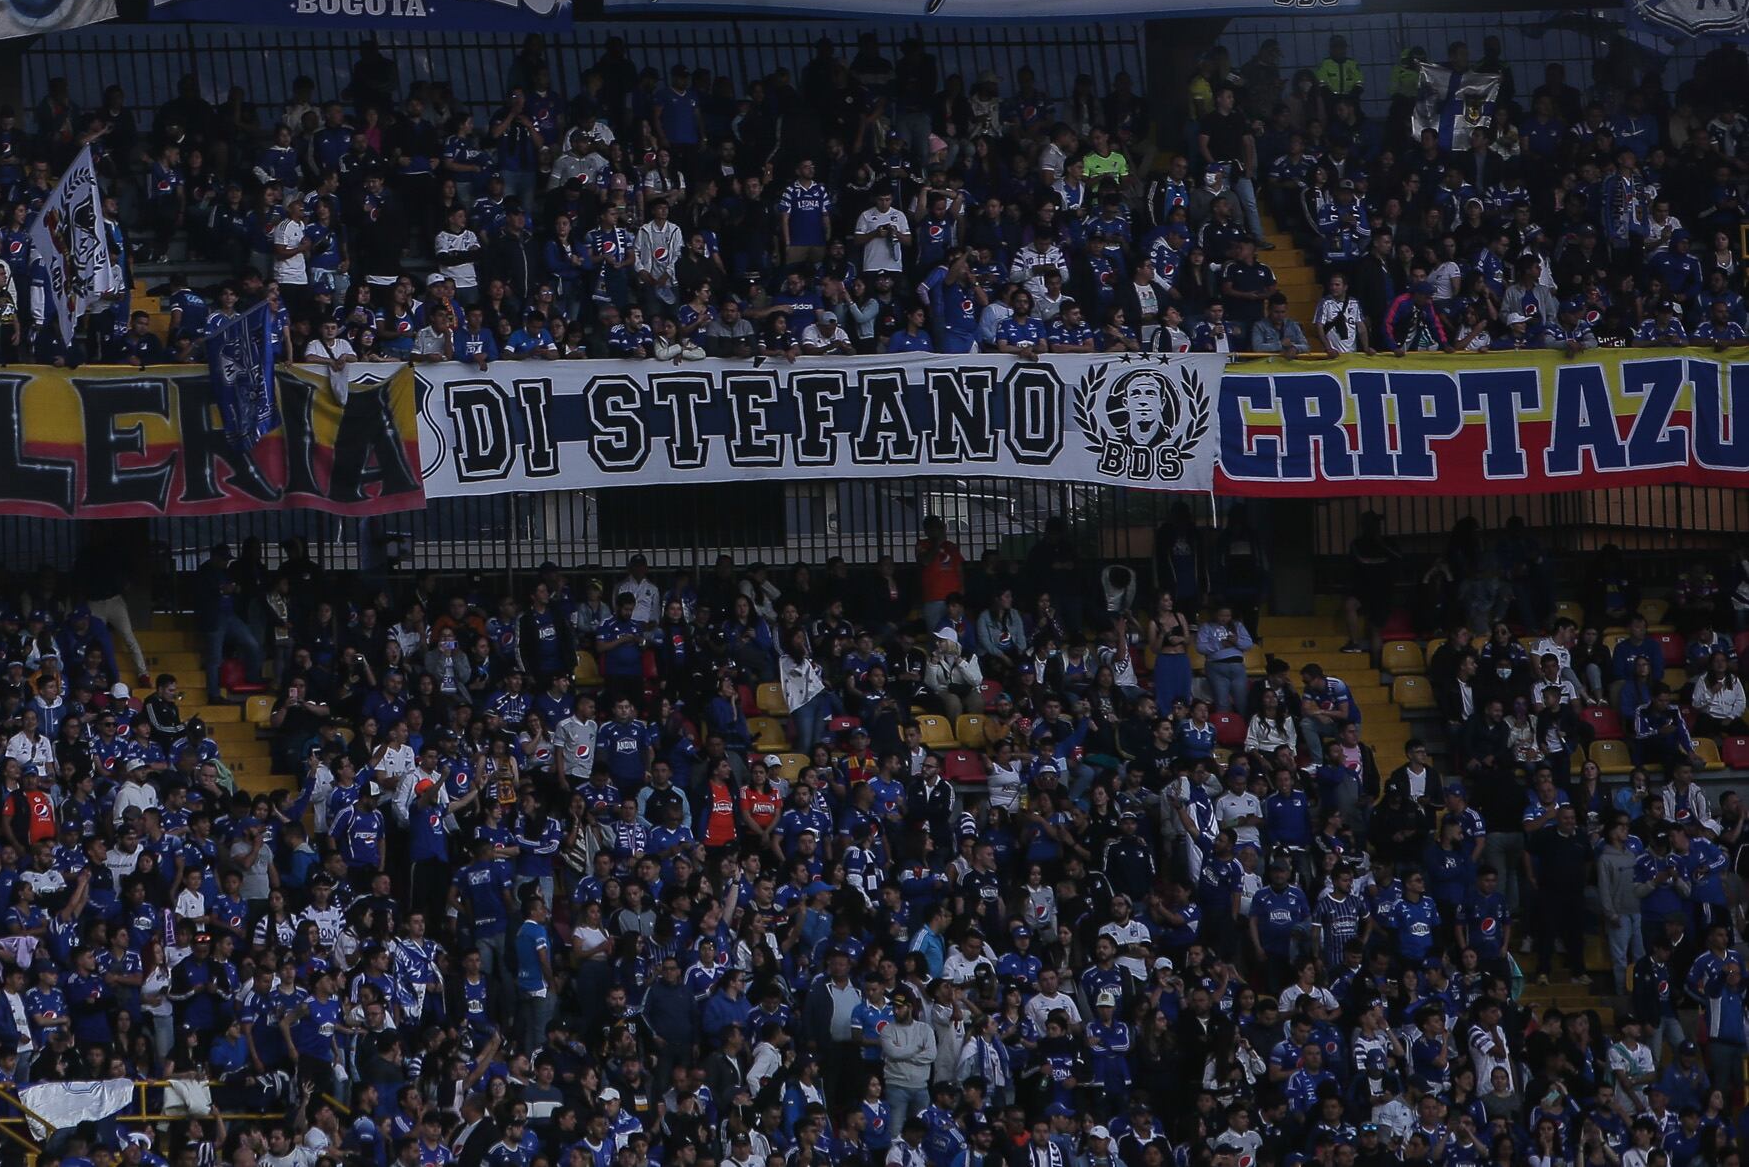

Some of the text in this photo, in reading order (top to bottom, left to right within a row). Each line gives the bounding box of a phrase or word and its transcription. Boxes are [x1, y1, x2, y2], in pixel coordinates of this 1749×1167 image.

[446, 361, 1066, 483] DI STEFANO
[1098, 436, 1184, 481] BDS
